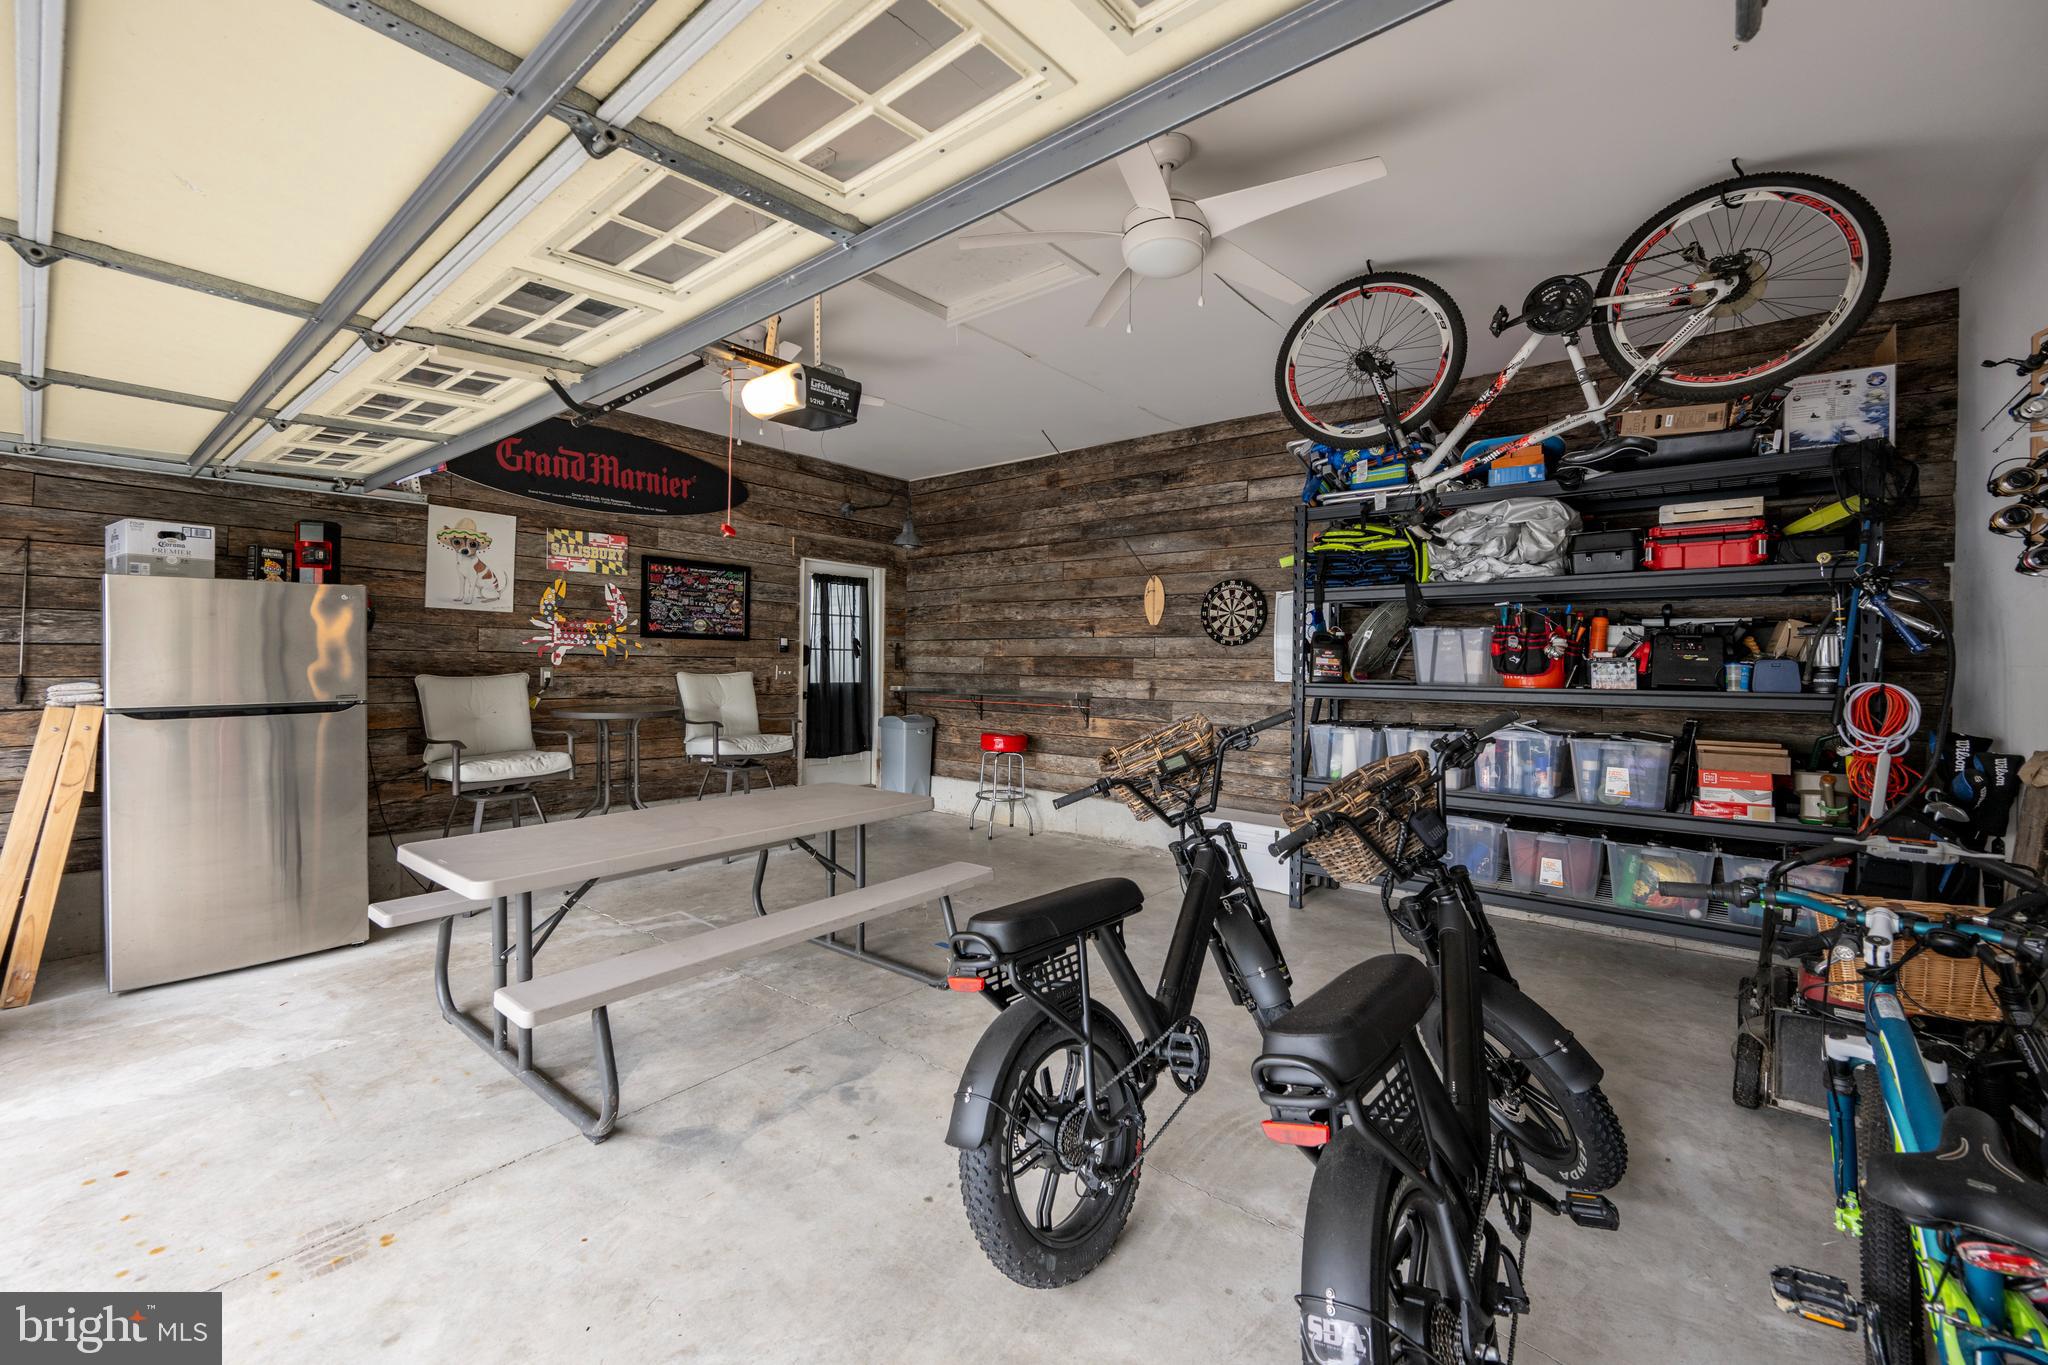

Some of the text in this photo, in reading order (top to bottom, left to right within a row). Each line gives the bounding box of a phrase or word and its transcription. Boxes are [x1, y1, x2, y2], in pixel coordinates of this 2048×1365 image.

[1788, 193, 1862, 258] GENESIS
[810, 379, 850, 397] LiftMaster
[496, 437, 692, 499] Grand Marnier
[151, 548, 192, 556] PREMIER
[158, 541, 186, 549] Corona
[550, 542, 625, 561] SALISBURY
[1954, 740, 1970, 772] Wilson
[1994, 757, 2008, 786] Wilson
[1558, 1135, 1588, 1181] KENDA
